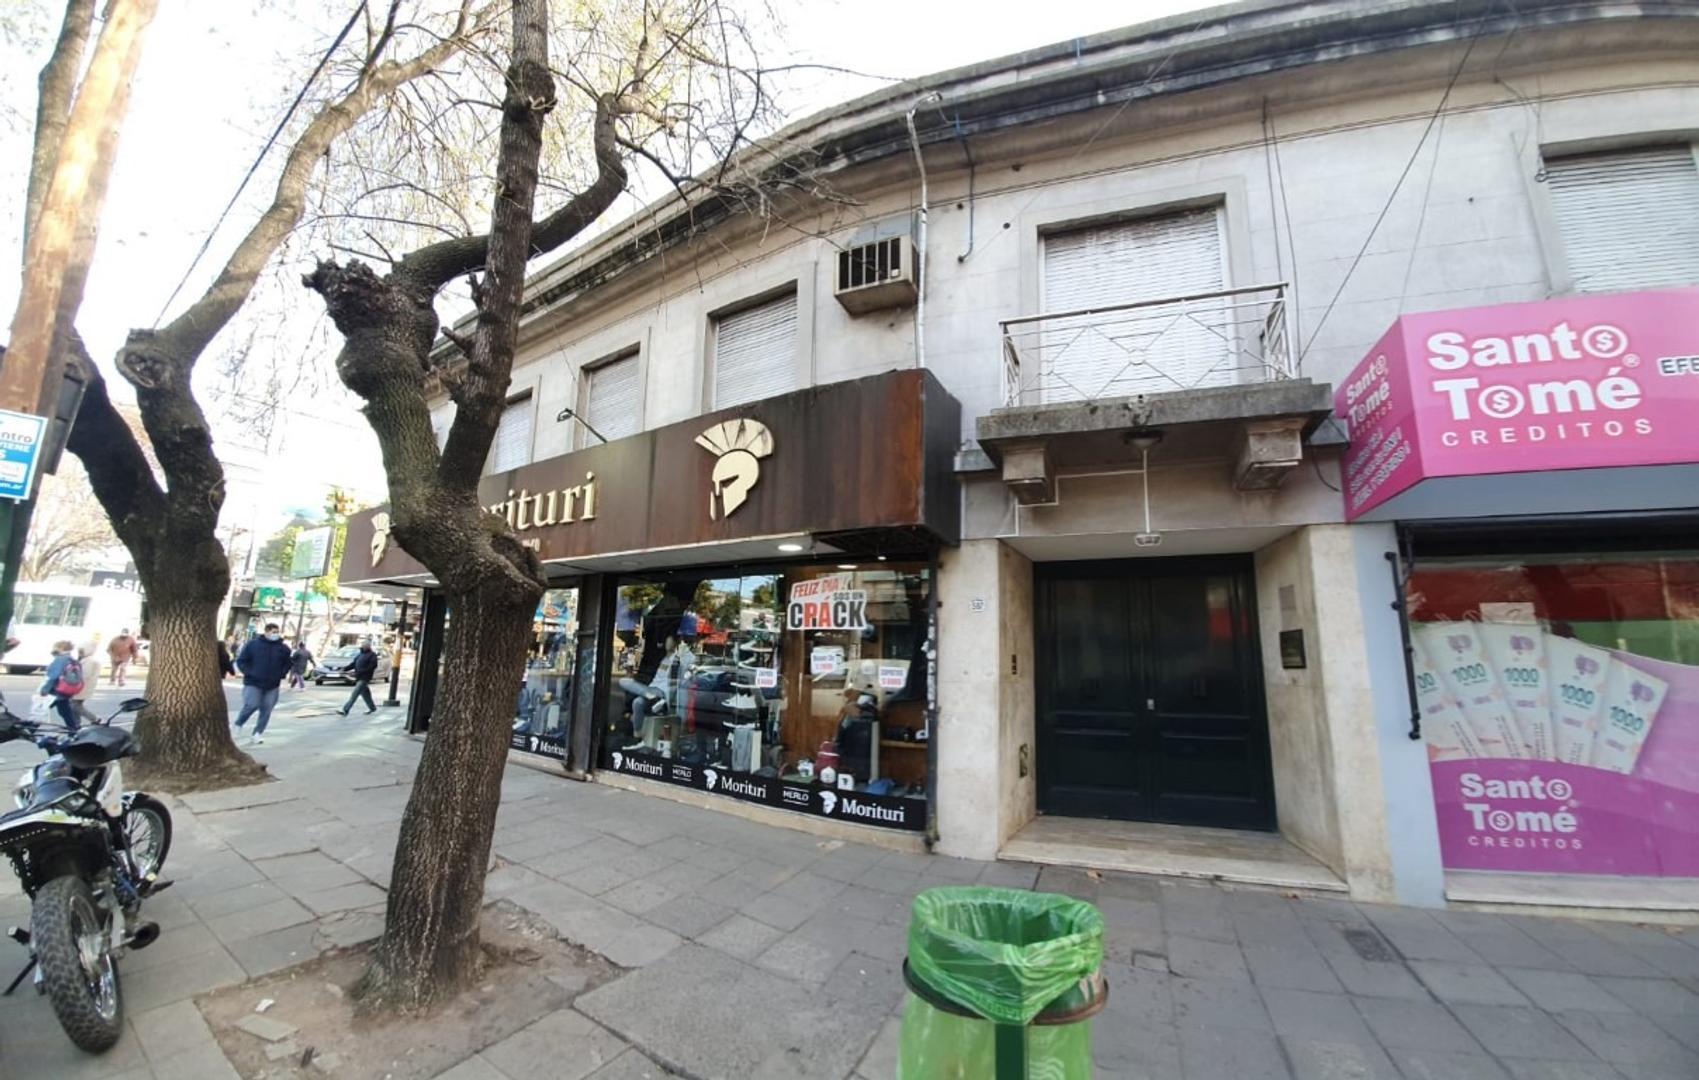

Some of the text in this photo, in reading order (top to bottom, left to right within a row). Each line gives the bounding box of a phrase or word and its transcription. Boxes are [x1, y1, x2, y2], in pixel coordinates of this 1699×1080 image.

[1432, 367, 1641, 420] Tomé
[1441, 418, 1652, 447] CREDITOS
[794, 582, 820, 599] FELIZ
[1452, 663, 1486, 682] 1000
[1504, 668, 1540, 682] 1000
[1560, 683, 1595, 705] 1000
[1609, 705, 1644, 731] 1000
[625, 757, 663, 777] Morituri
[721, 775, 766, 799] Morituri
[842, 798, 905, 823] Morituri
[1463, 803, 1578, 833] Tomé
[1467, 836, 1582, 850] CREDITOS
